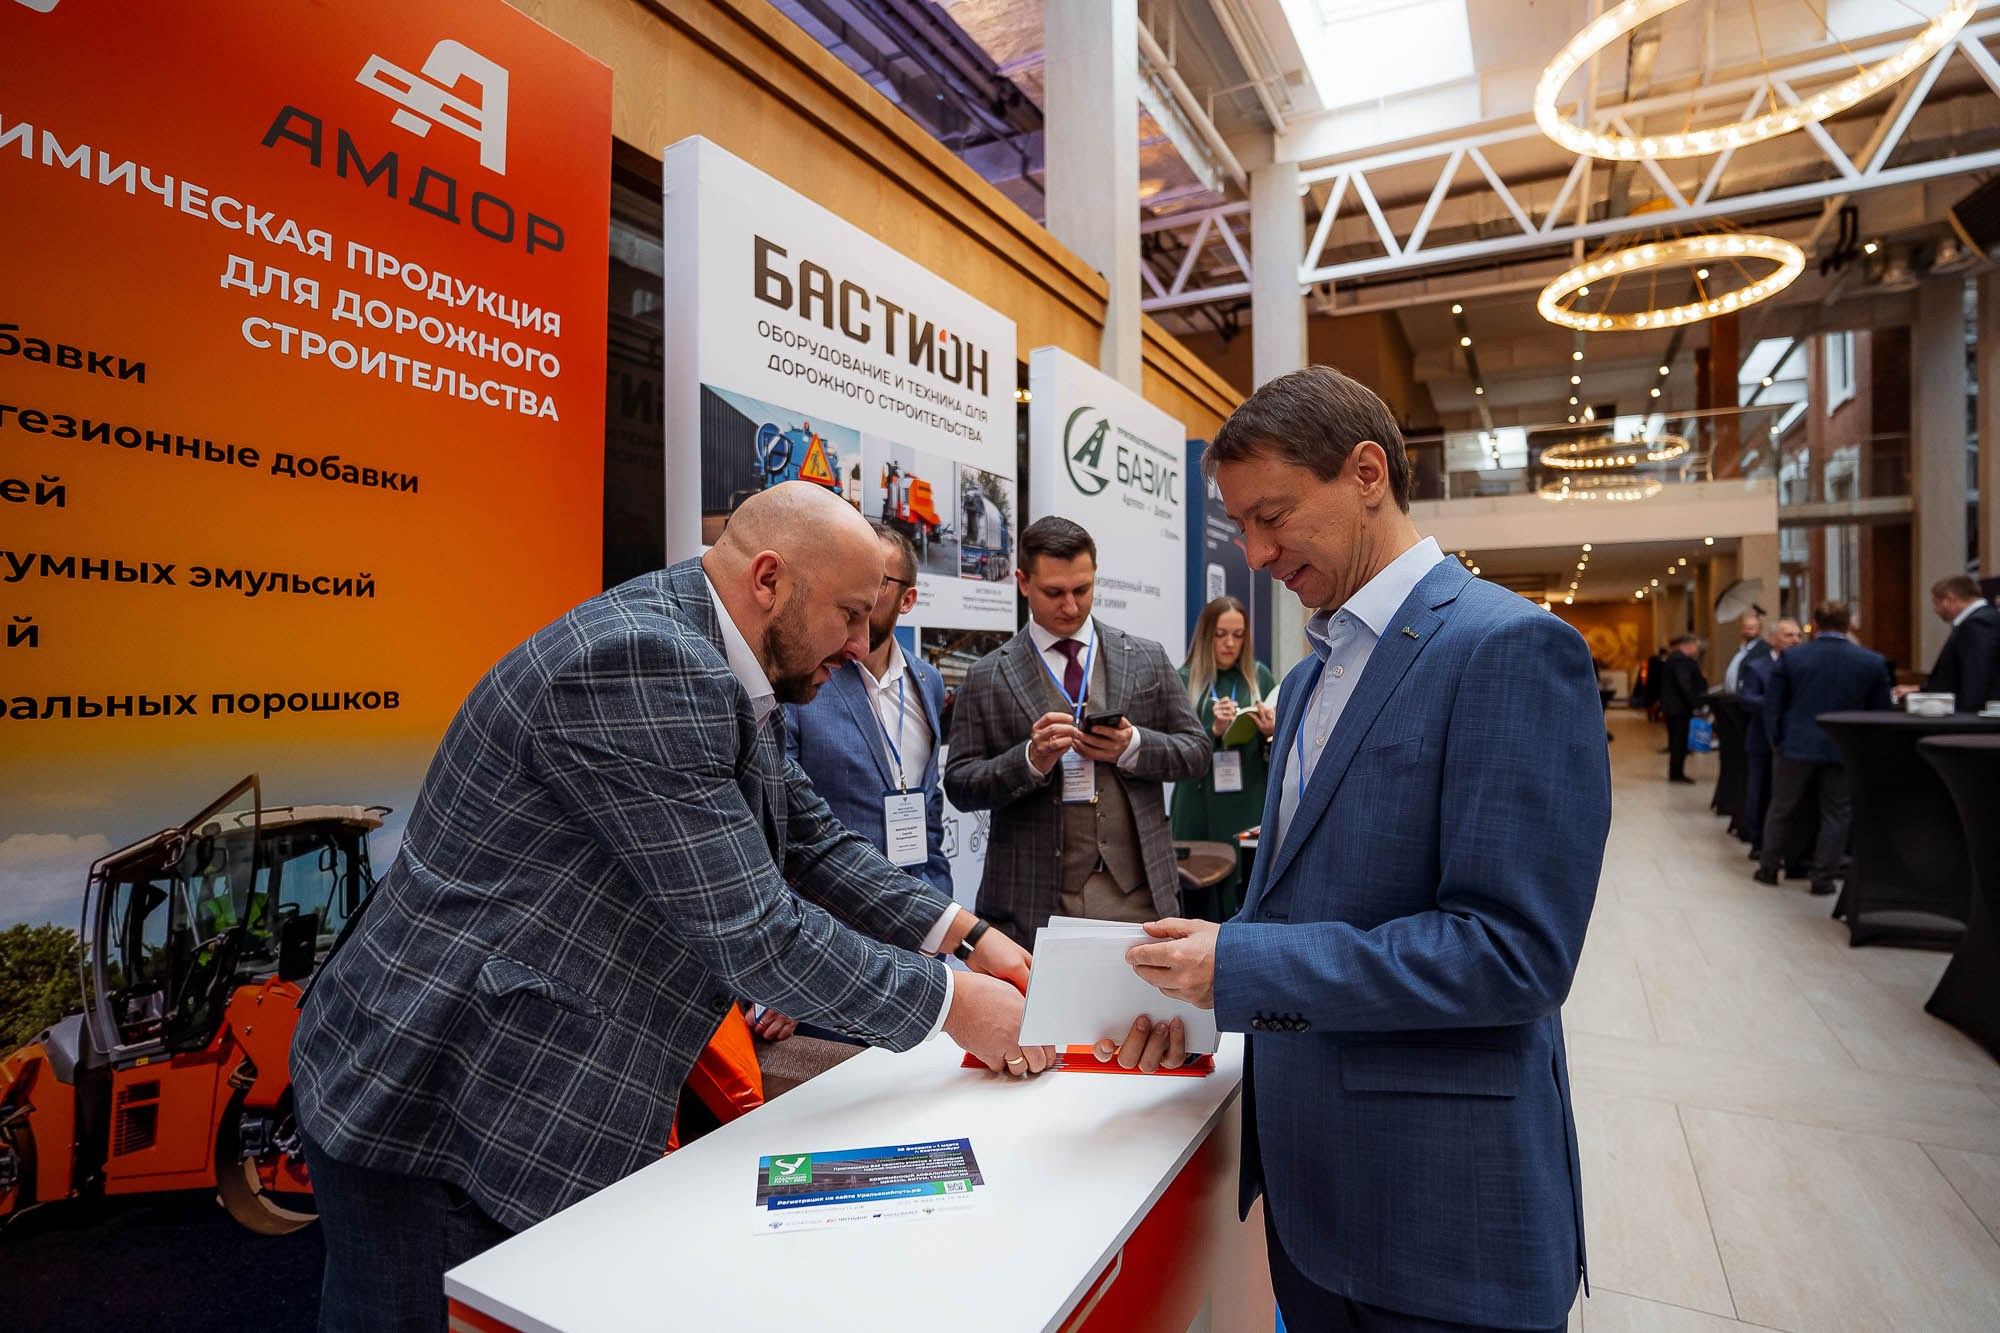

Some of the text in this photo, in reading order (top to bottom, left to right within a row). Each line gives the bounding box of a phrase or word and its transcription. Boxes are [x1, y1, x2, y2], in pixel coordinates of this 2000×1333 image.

[0, 114, 561, 338] ИМИЧЕСКАЯ ПРОДУКЦИЯ
[261, 105, 565, 254] АМДОР
[220, 254, 560, 378] ДЛЯ ДОРОЖНОГО
[754, 234, 989, 397] БАСТИОН
[241, 316, 559, 422] СТРОИТЕЛЬСТВА
[758, 320, 988, 423] ОБОРУДОВАНИЕ И ТЕХНИКА ДЛЯ
[767, 354, 983, 443] ДОРОЖНОГО СТРОИТЕЛЬСТВА
[271, 450, 418, 494] добавки
[1116, 445, 1178, 506] БАЗИС
[0, 551, 375, 599] умных эмульсий
[0, 689, 400, 719] альных порошков
[777, 1197, 824, 1206] Регистрация
